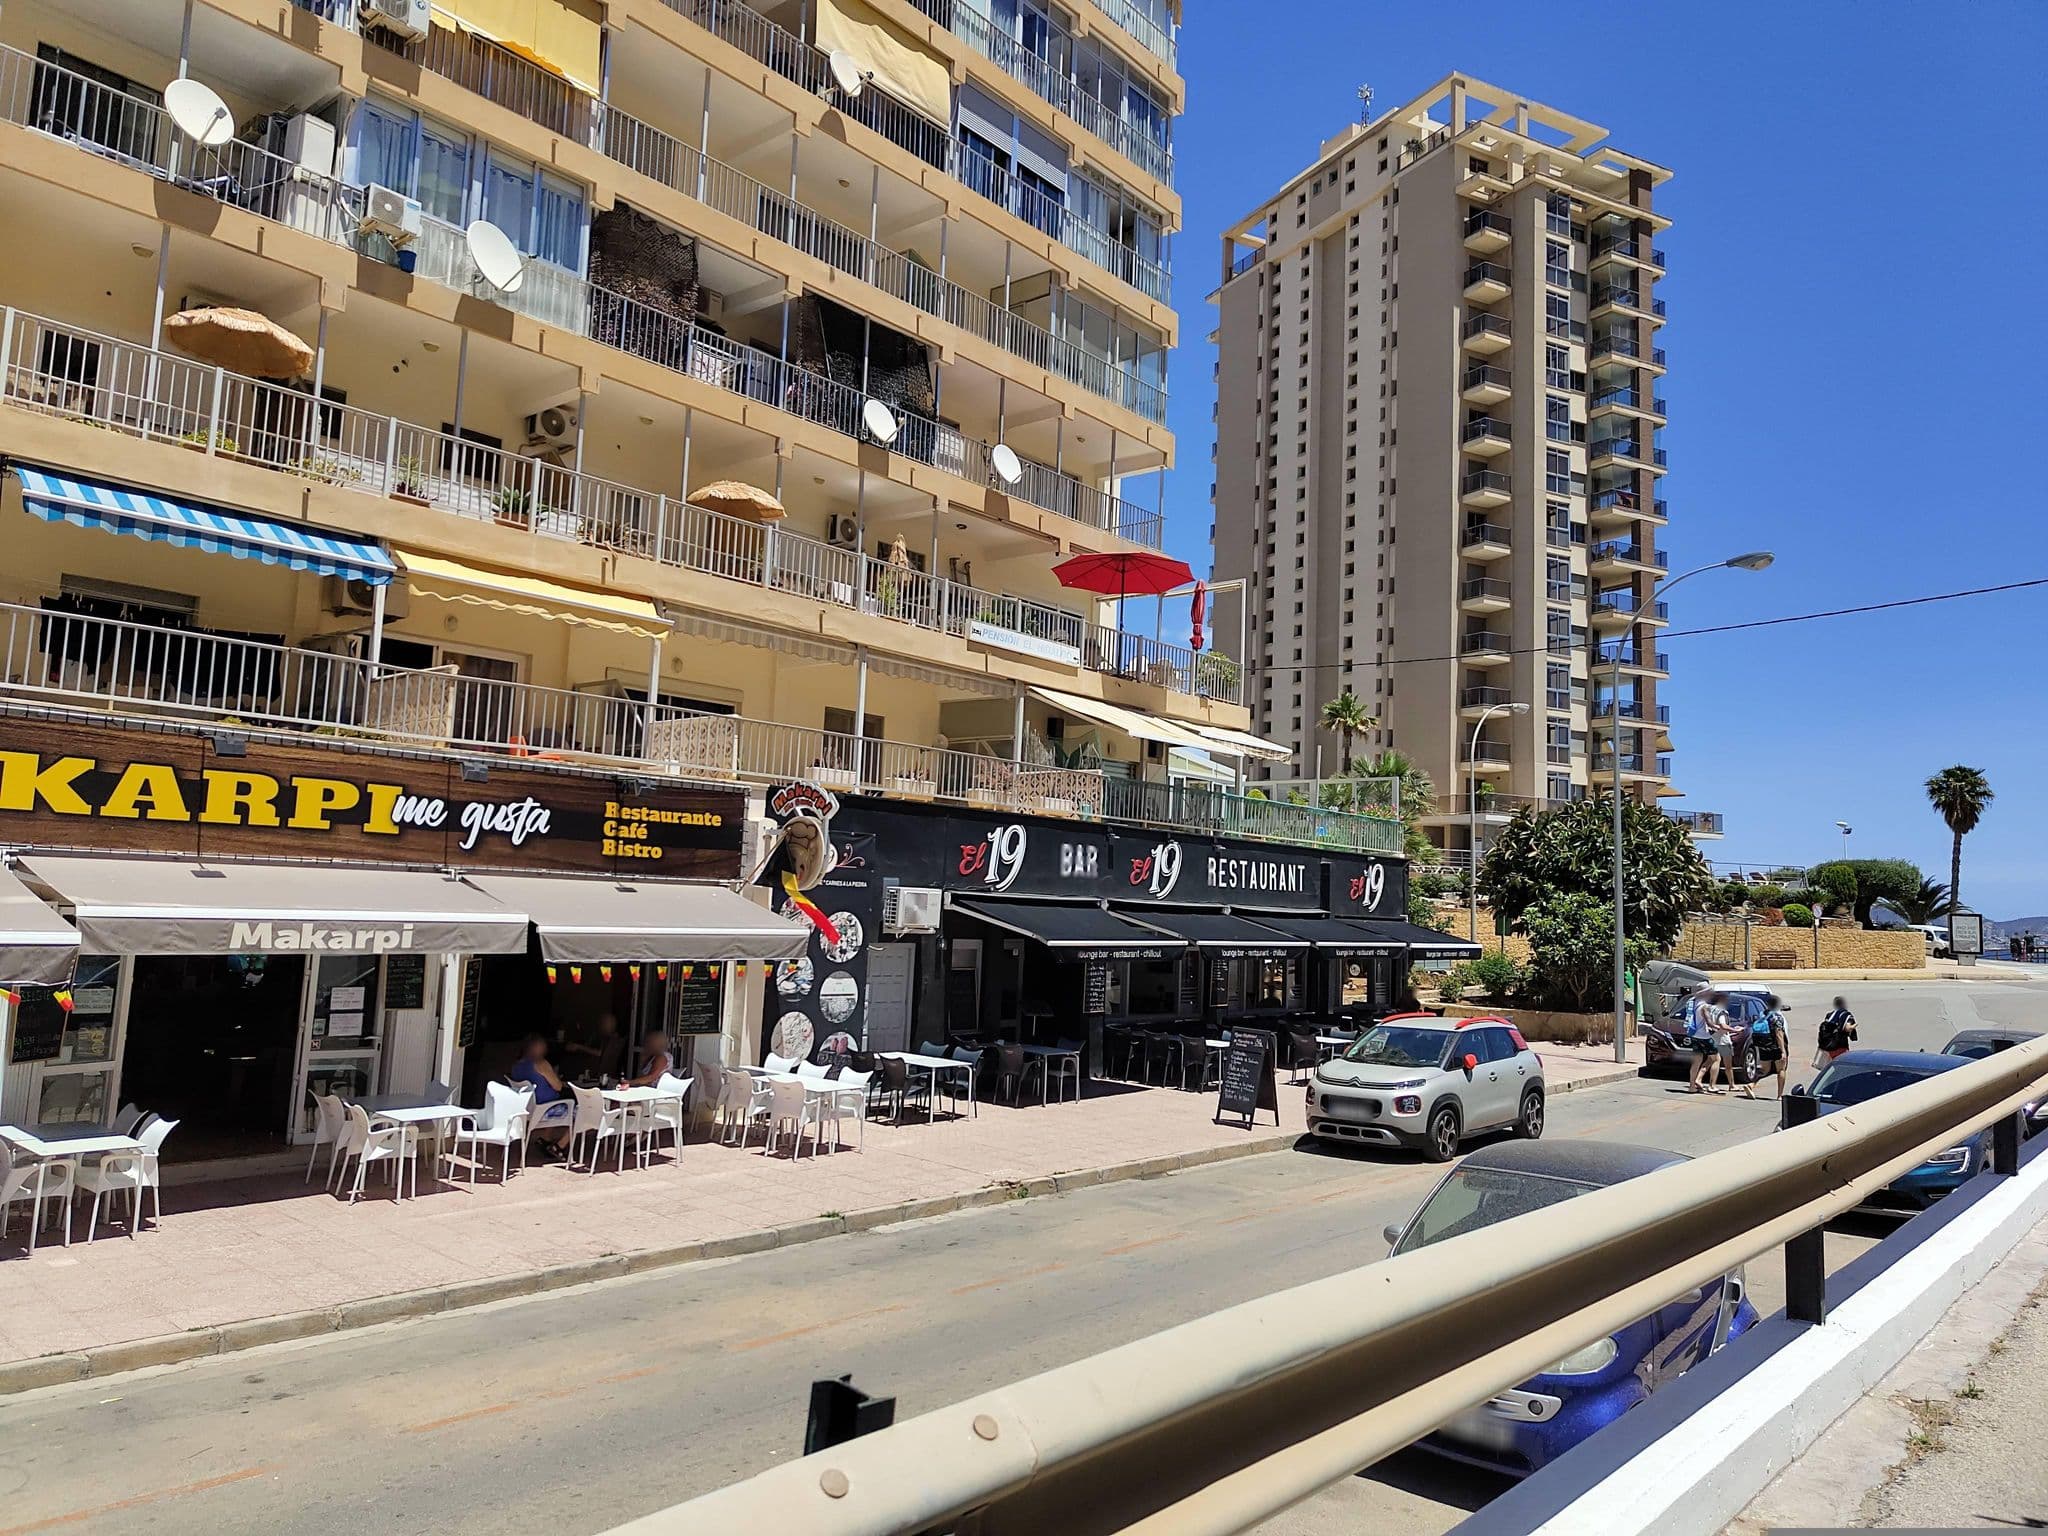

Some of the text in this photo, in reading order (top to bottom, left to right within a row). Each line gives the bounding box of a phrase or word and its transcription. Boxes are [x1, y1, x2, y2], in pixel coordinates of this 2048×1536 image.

[982, 628, 1018, 645] PENSIÓN
[604, 801, 722, 827] Restaurante
[773, 781, 834, 816] Makarpi
[391, 793, 448, 827] me
[459, 796, 551, 850] gusta
[603, 820, 648, 839] Café
[601, 838, 663, 859] Bistro
[959, 824, 1027, 892] El 19
[1060, 843, 1099, 878] BAR
[1129, 840, 1183, 900] El 19
[1208, 857, 1306, 892] RESTAURANT
[1350, 863, 1385, 912] El 19
[229, 921, 415, 954] Makarpi
[1078, 950, 1098, 959] lounge
[1098, 949, 1109, 958] bar
[1113, 949, 1140, 958] restaurant
[1143, 949, 1162, 958] chillout
[1221, 949, 1237, 958] lounge
[1237, 949, 1245, 957] bar
